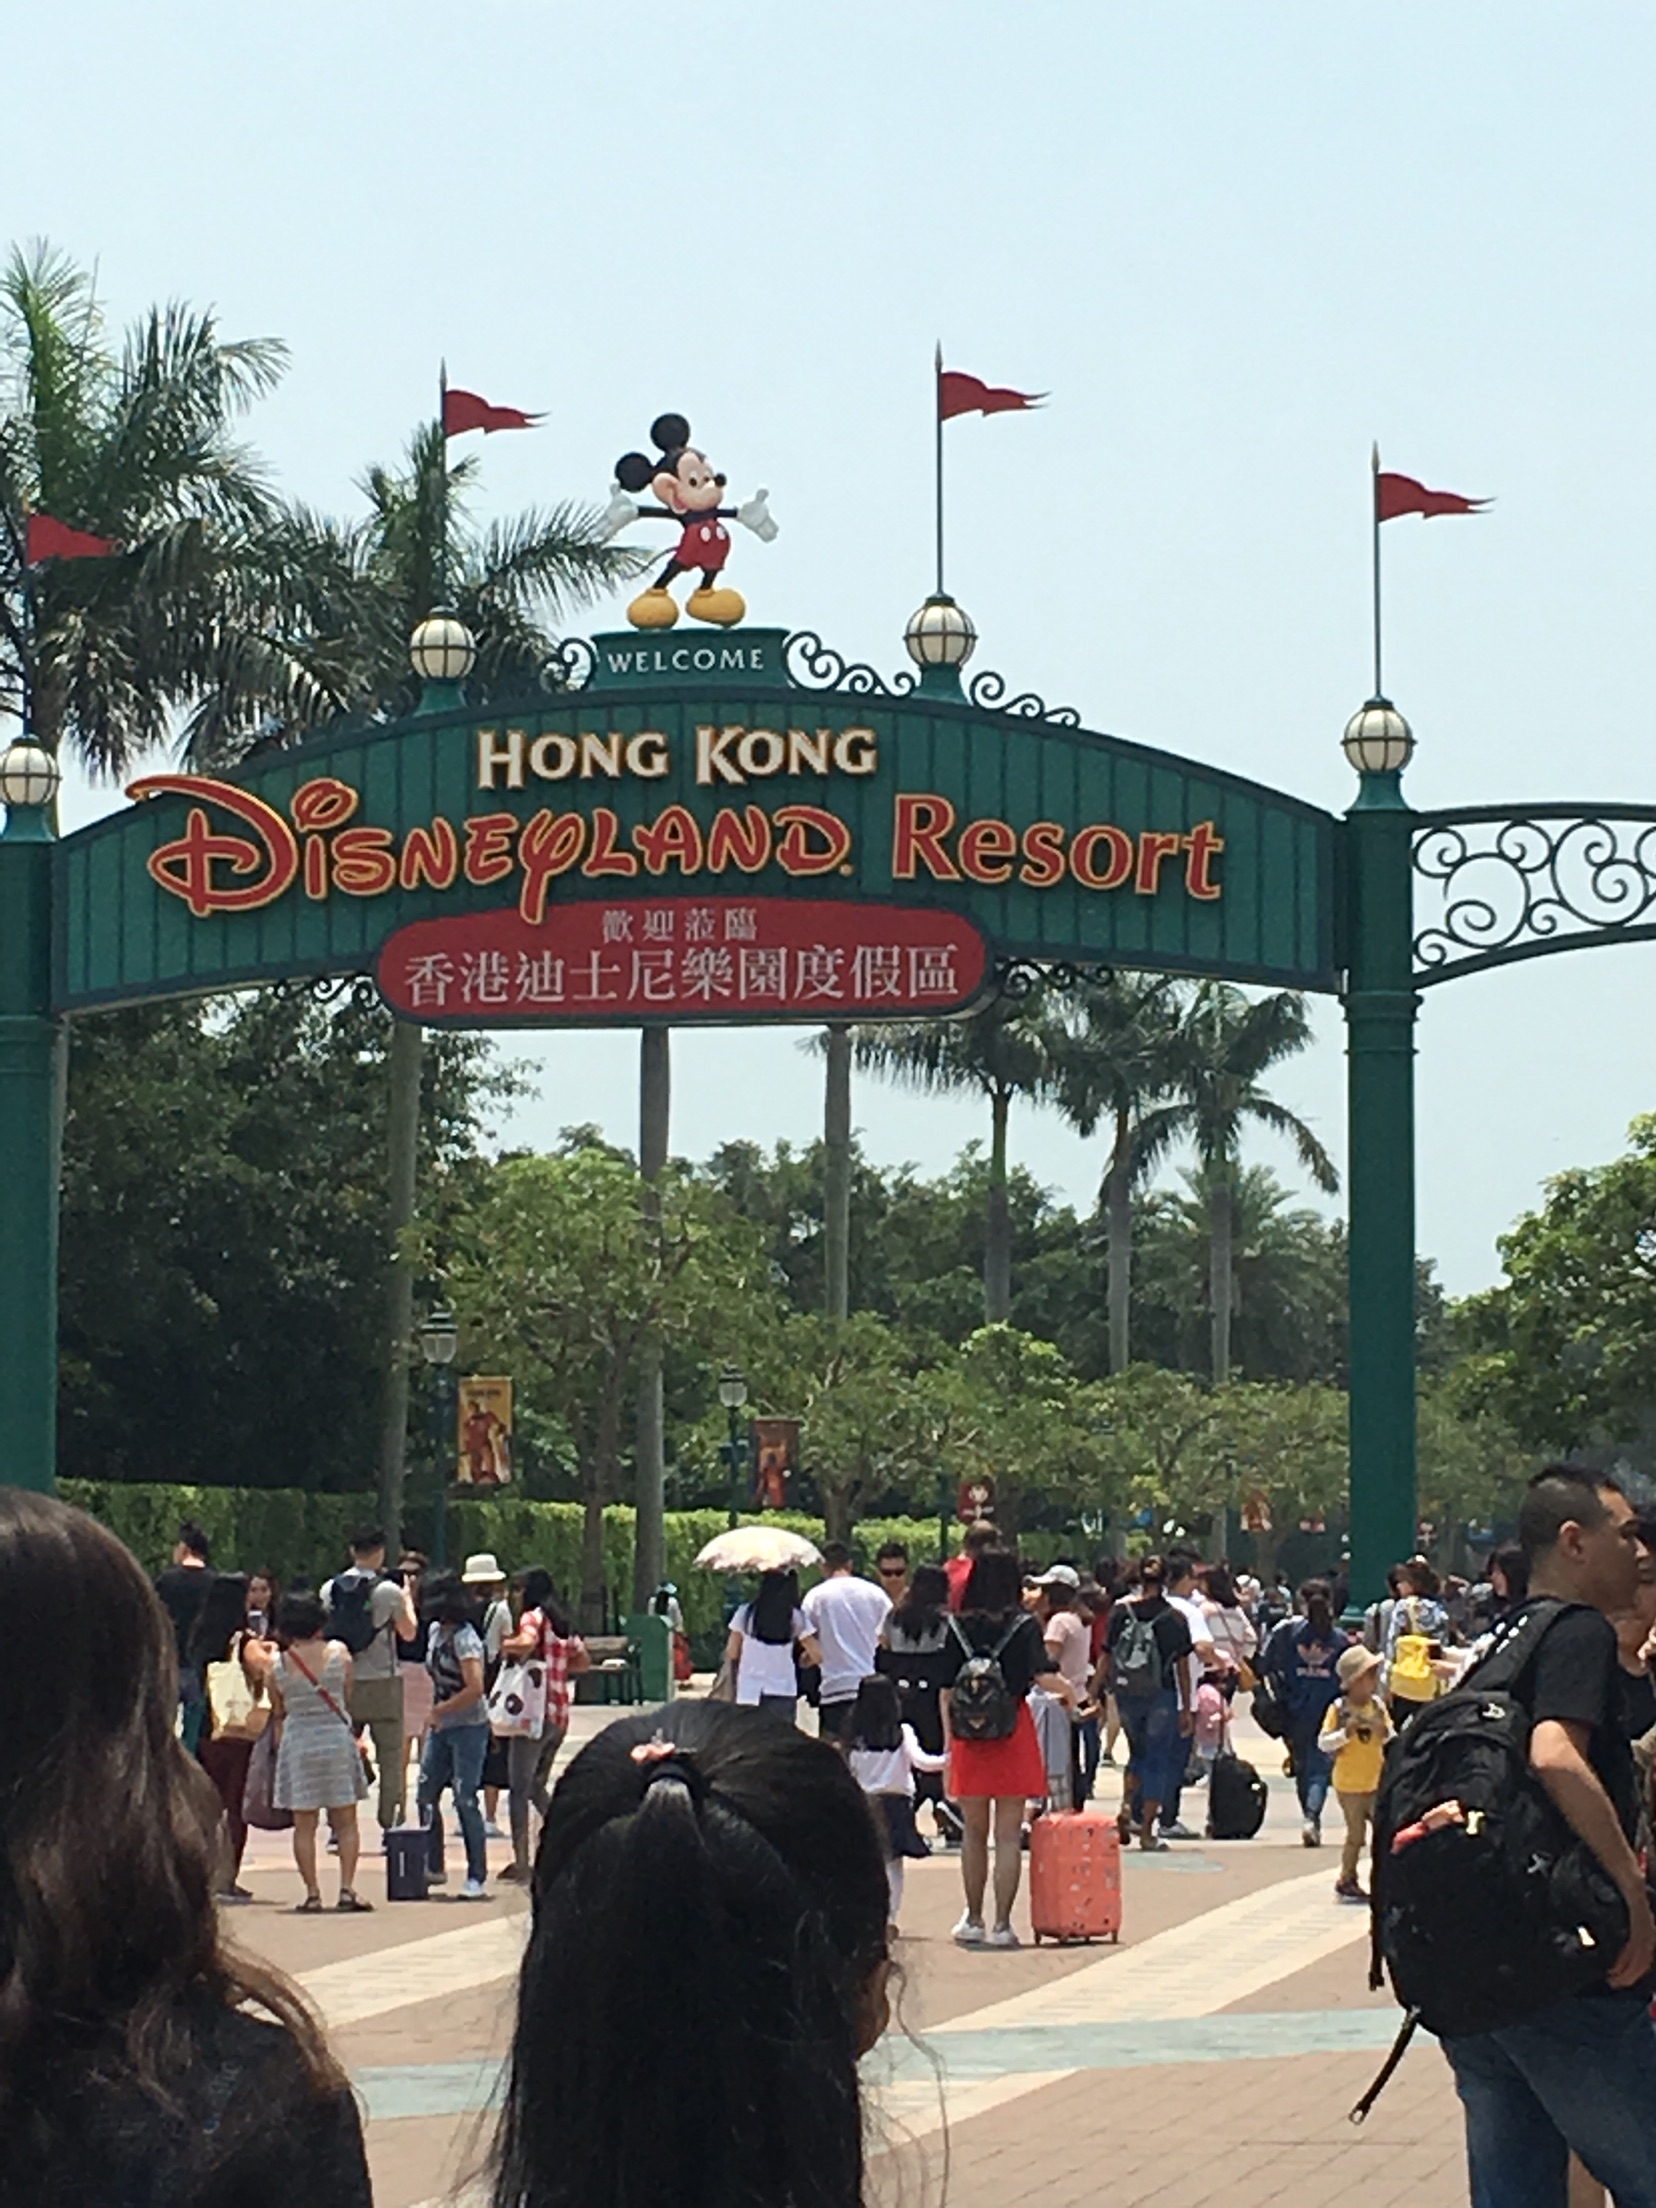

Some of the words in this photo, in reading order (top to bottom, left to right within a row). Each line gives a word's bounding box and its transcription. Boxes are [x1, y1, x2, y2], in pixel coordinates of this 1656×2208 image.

[607, 649, 764, 673] WELCOME
[476, 727, 668, 788] HONG
[695, 726, 877, 785] KONG
[891, 793, 1225, 900] Resort
[404, 945, 959, 1006] 香港迪士尼樂園度假區
